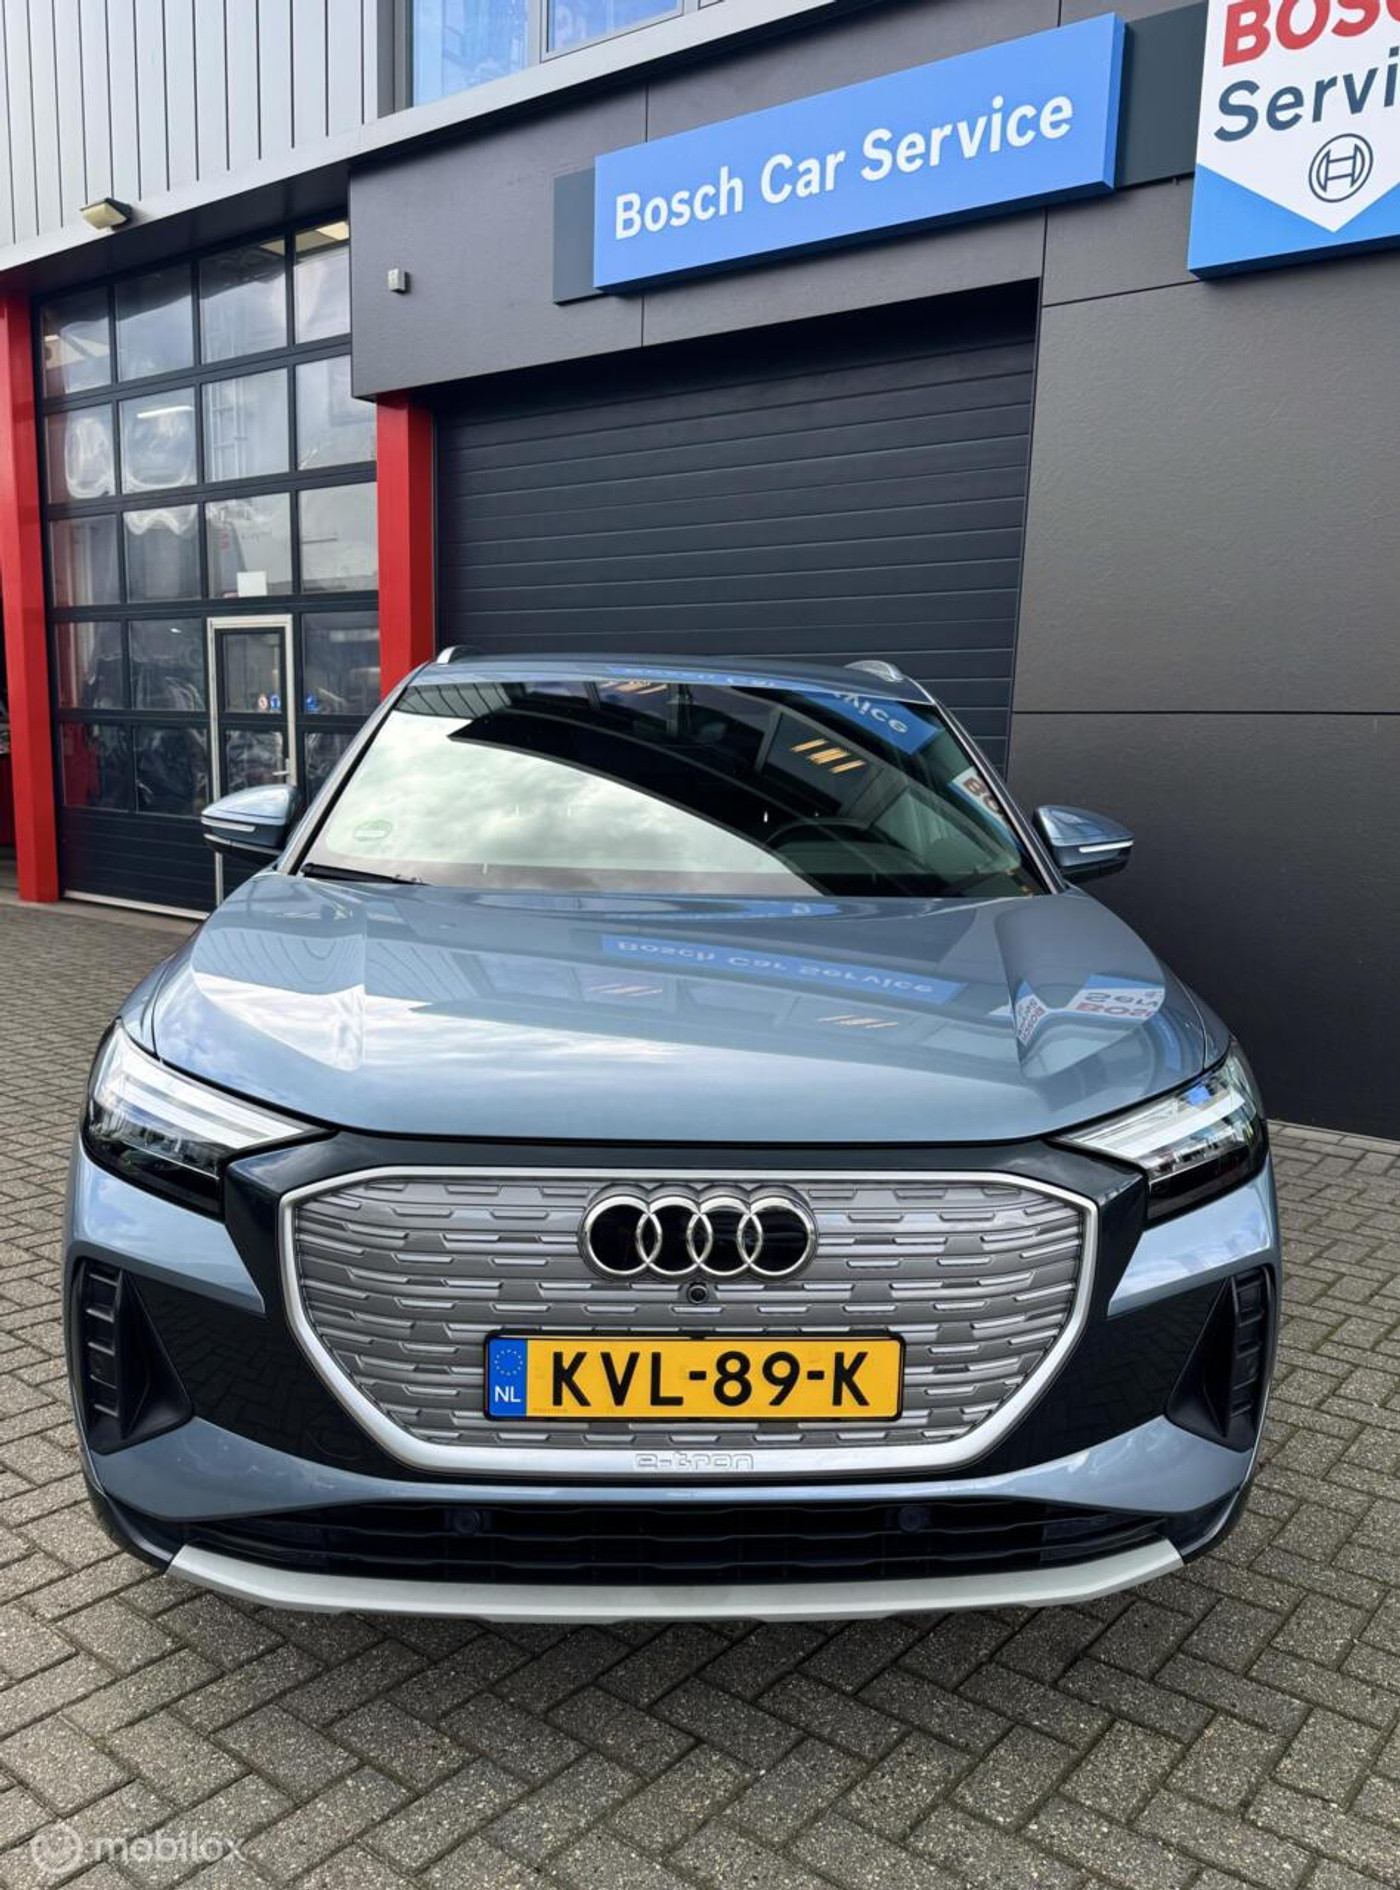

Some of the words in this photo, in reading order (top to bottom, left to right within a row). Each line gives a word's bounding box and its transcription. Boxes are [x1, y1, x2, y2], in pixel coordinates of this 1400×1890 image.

[1223, 0, 1400, 67] BOS
[1214, 45, 1400, 143] Servi
[615, 165, 743, 240] Bosch
[760, 150, 846, 204] Car
[860, 95, 1073, 181] Service
[494, 1386, 521, 1403] NL
[552, 1350, 870, 1407] KVL-89-K
[635, 1450, 754, 1470] e-tron
